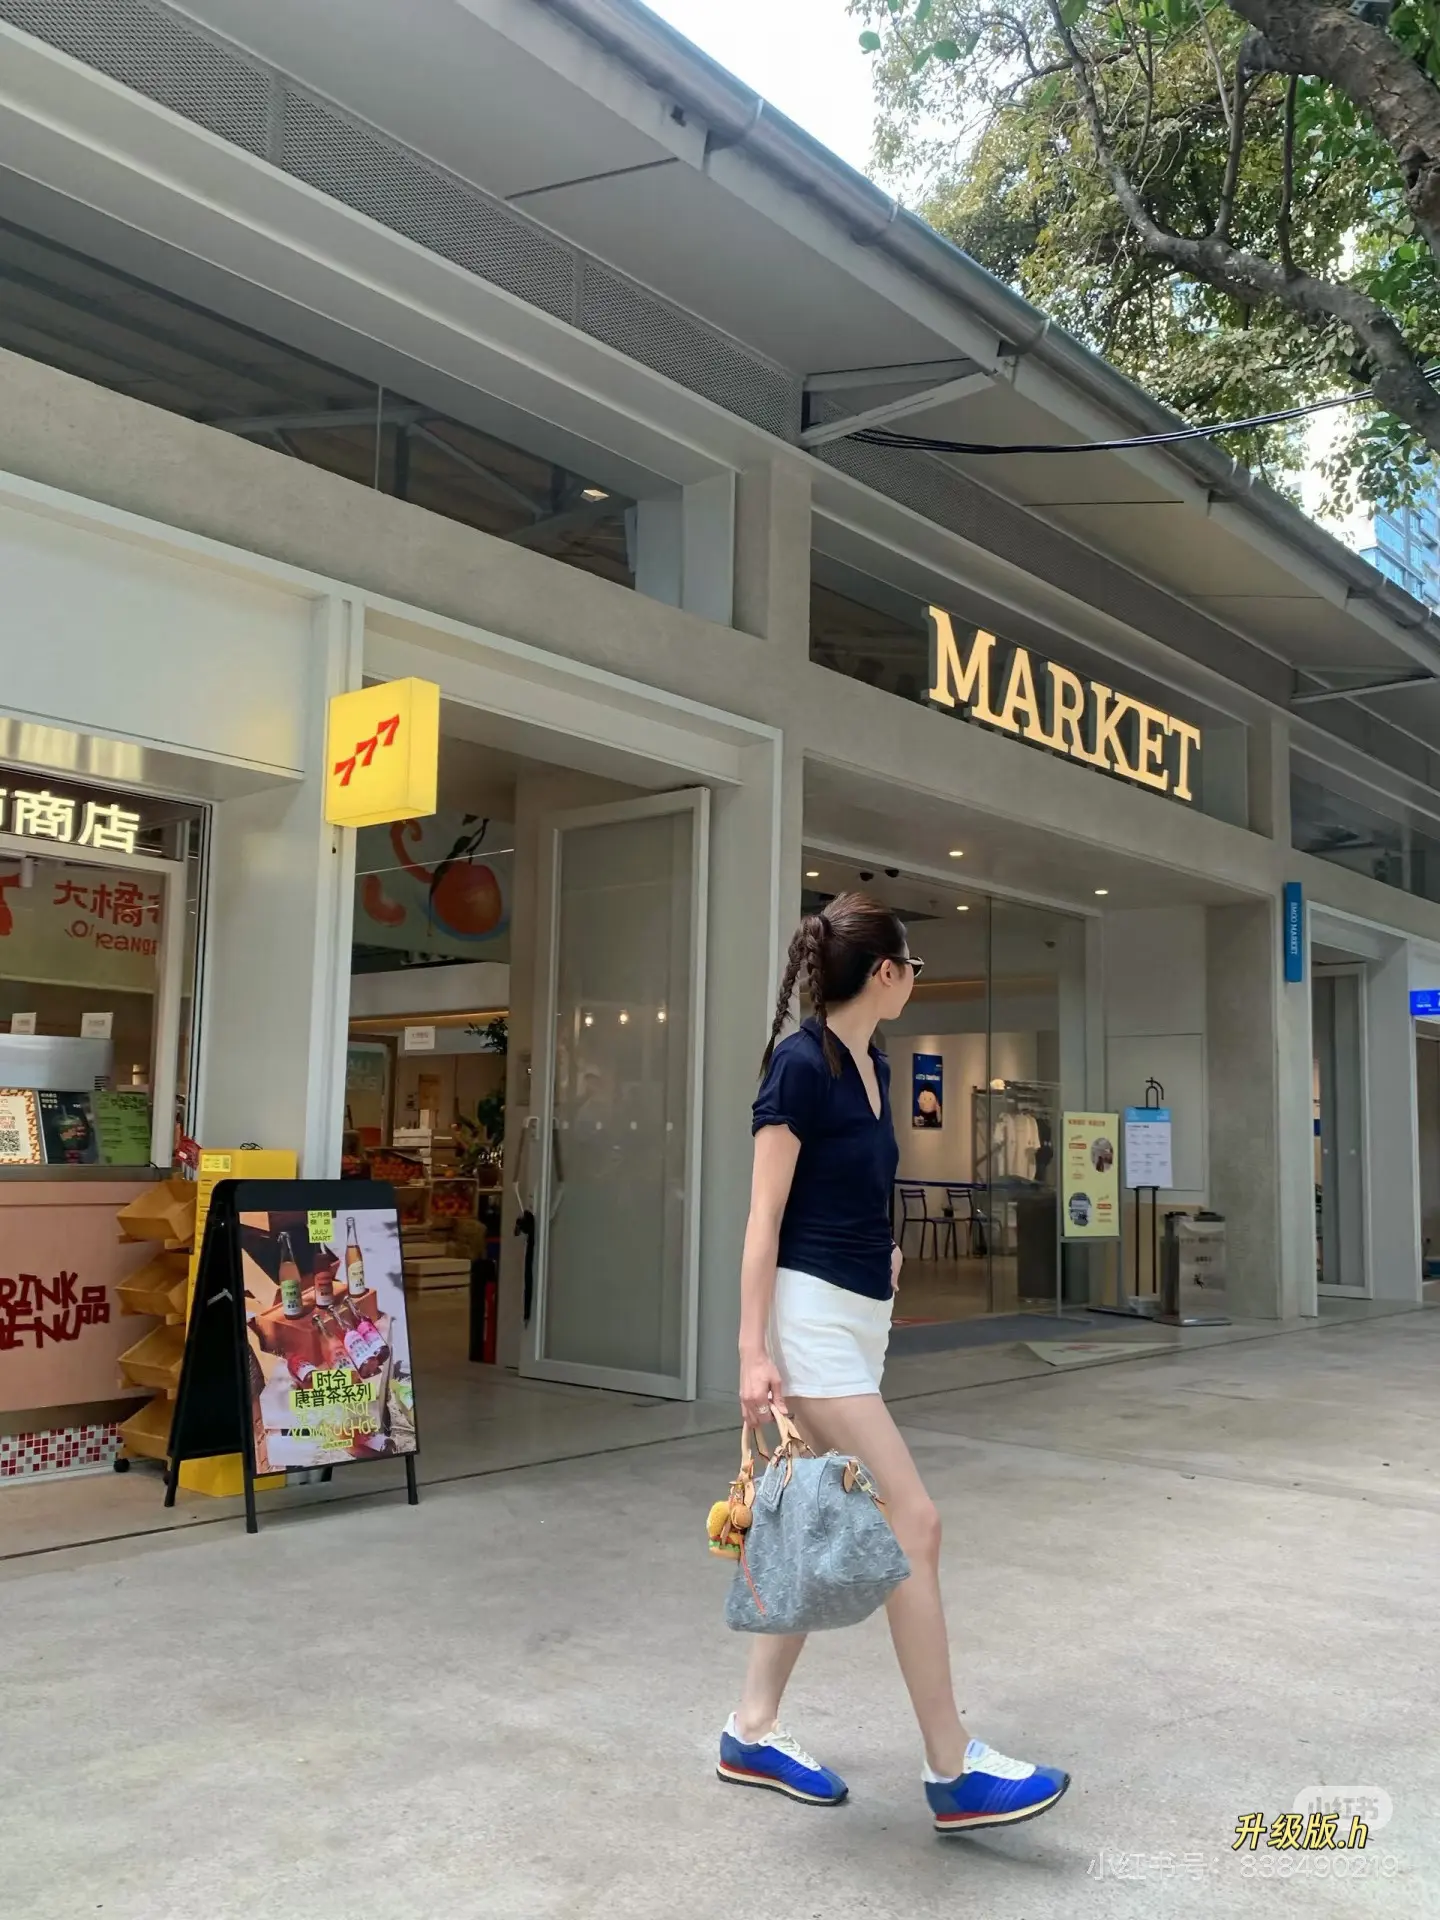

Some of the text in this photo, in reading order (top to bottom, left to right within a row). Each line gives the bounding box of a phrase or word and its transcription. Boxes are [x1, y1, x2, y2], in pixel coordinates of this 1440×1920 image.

[928, 605, 1202, 802] MARKET
[1290, 924, 1298, 955] MARKET
[76, 1285, 110, 1324] 品
[317, 1369, 347, 1389] 时令
[295, 1383, 371, 1408] 康普茶系列
